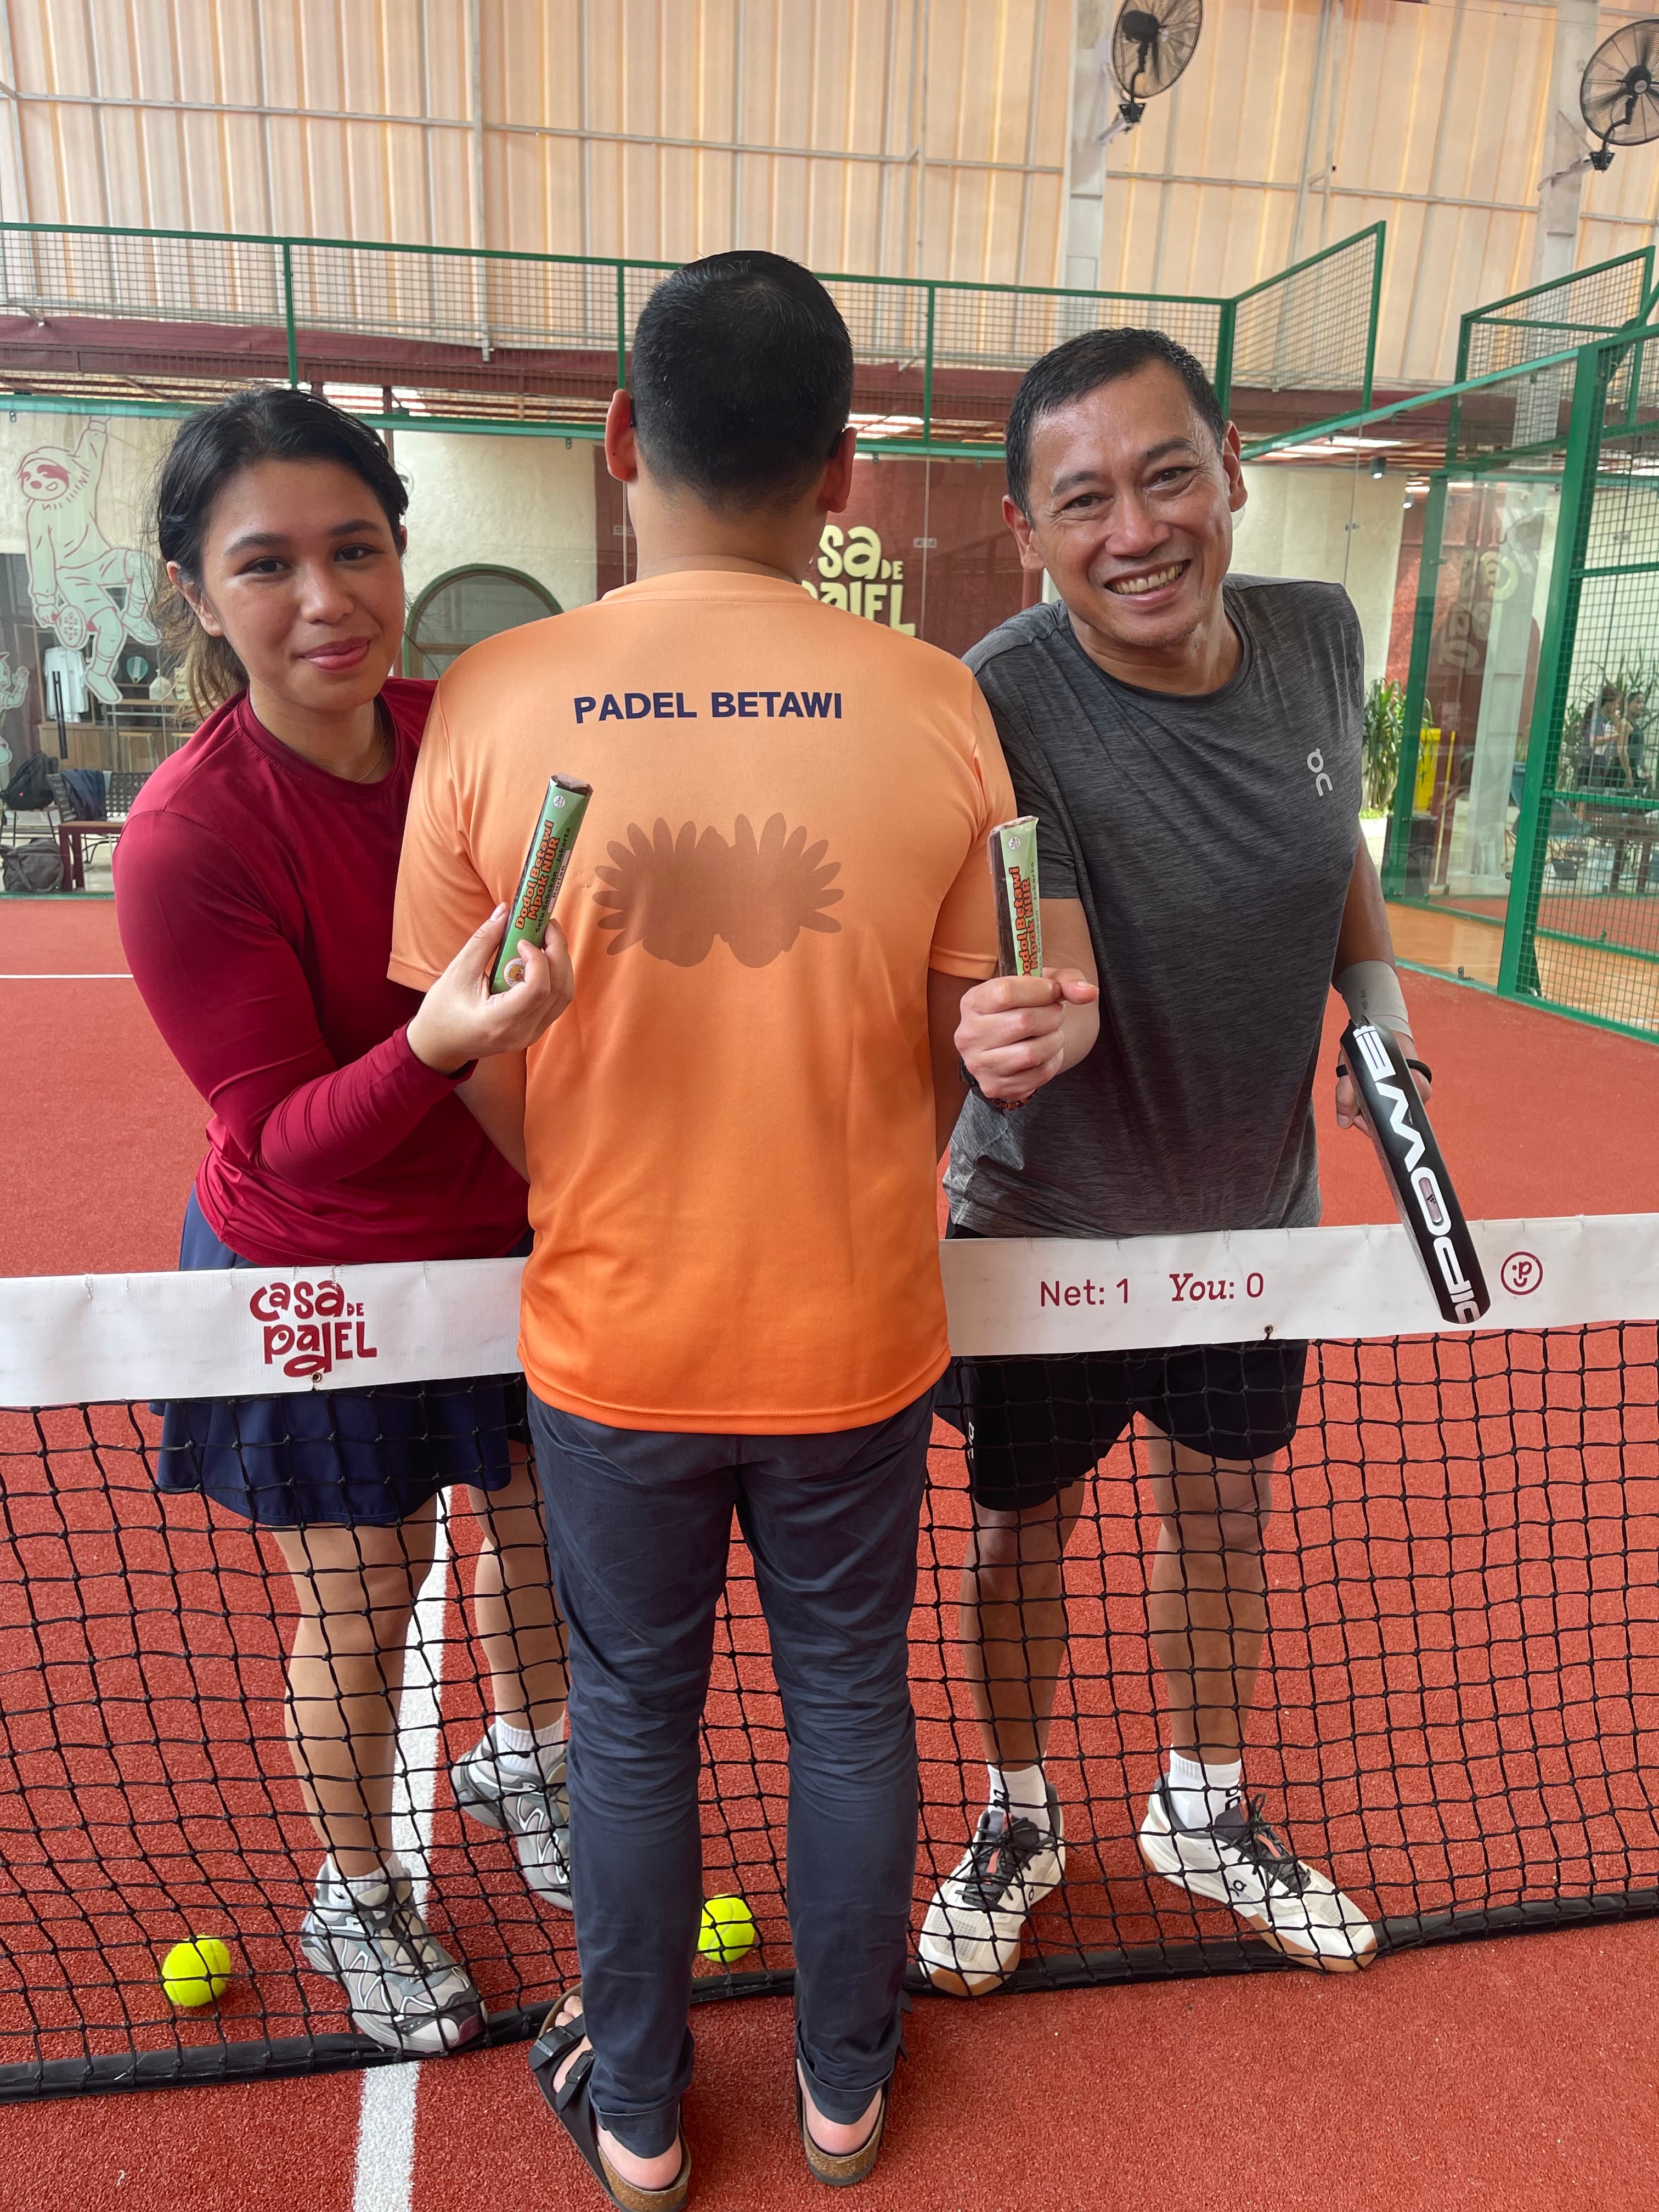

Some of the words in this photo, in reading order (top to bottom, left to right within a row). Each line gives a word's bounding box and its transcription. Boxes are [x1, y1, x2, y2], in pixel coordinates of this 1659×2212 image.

[574, 692, 697, 724] PADEL
[711, 692, 842, 719] BETAWI
[515, 880, 537, 930] Dodol
[530, 819, 554, 879] Betawi
[527, 874, 549, 921] Mpok
[541, 837, 560, 873] NUR
[535, 912, 545, 933] Setu
[541, 871, 557, 911] Babakan
[556, 828, 571, 863] Jakarta
[552, 866, 565, 898] Durian
[1008, 866, 1026, 930] Betawi
[1022, 877, 1034, 918] NUR
[1017, 932, 1032, 976] odol
[1026, 918, 1039, 970] Mpok
[347, 1302, 364, 1317] DE
[1041, 1279, 1104, 1307] Net:
[1116, 1278, 1128, 1304] 1
[1169, 1273, 1234, 1302] You:
[1246, 1272, 1264, 1298] 0
